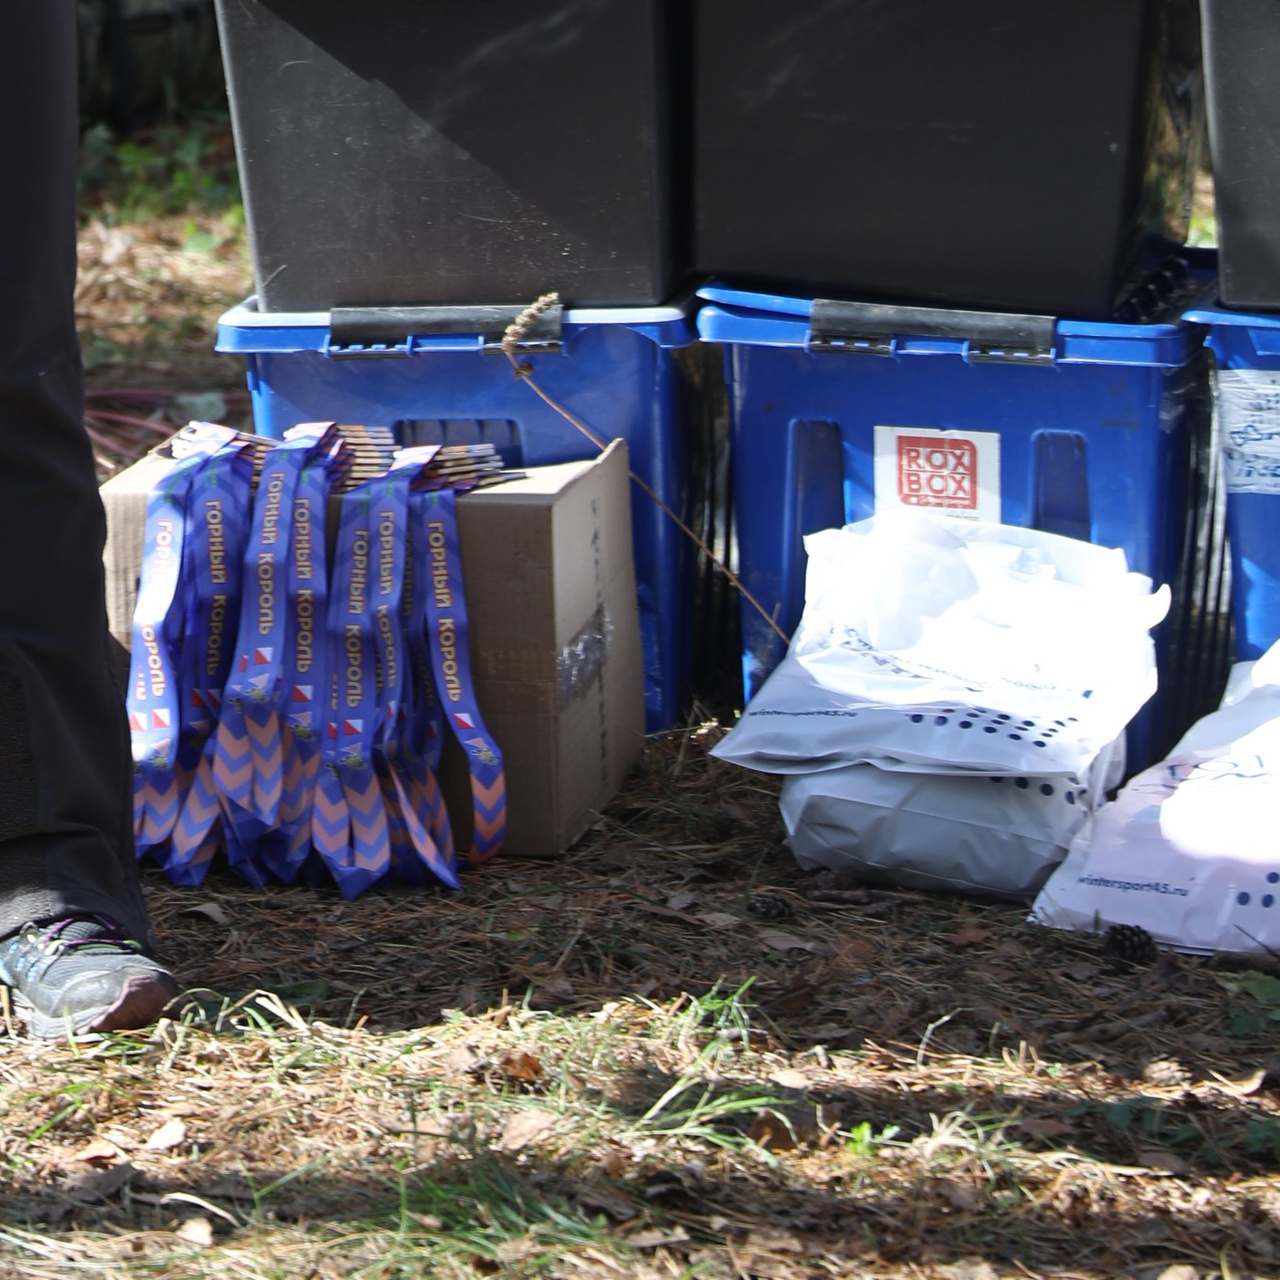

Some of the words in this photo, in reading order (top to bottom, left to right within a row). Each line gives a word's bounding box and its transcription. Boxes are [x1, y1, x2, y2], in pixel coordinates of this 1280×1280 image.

[906, 473, 968, 496] BOX
[907, 448, 968, 472] ROX
[205, 500, 227, 584] ГОРНЫЙ
[261, 471, 285, 545] ГОРНЫЙ
[294, 498, 313, 580] ГОРНЫЙ
[258, 552, 274, 635] КОРОЛЬ
[348, 529, 369, 614] ГОРНЫЙ
[378, 510, 396, 595] ГОРНЫЙ
[427, 521, 453, 608] ГОРНЫЙ
[140, 624, 166, 697] ОРОЛЬ
[207, 594, 227, 676] КОРОЛЬ
[295, 589, 313, 673] КОРОЛЬ
[345, 624, 363, 709] КОРОЛЬ
[438, 617, 461, 702] КОРОЛЬ
